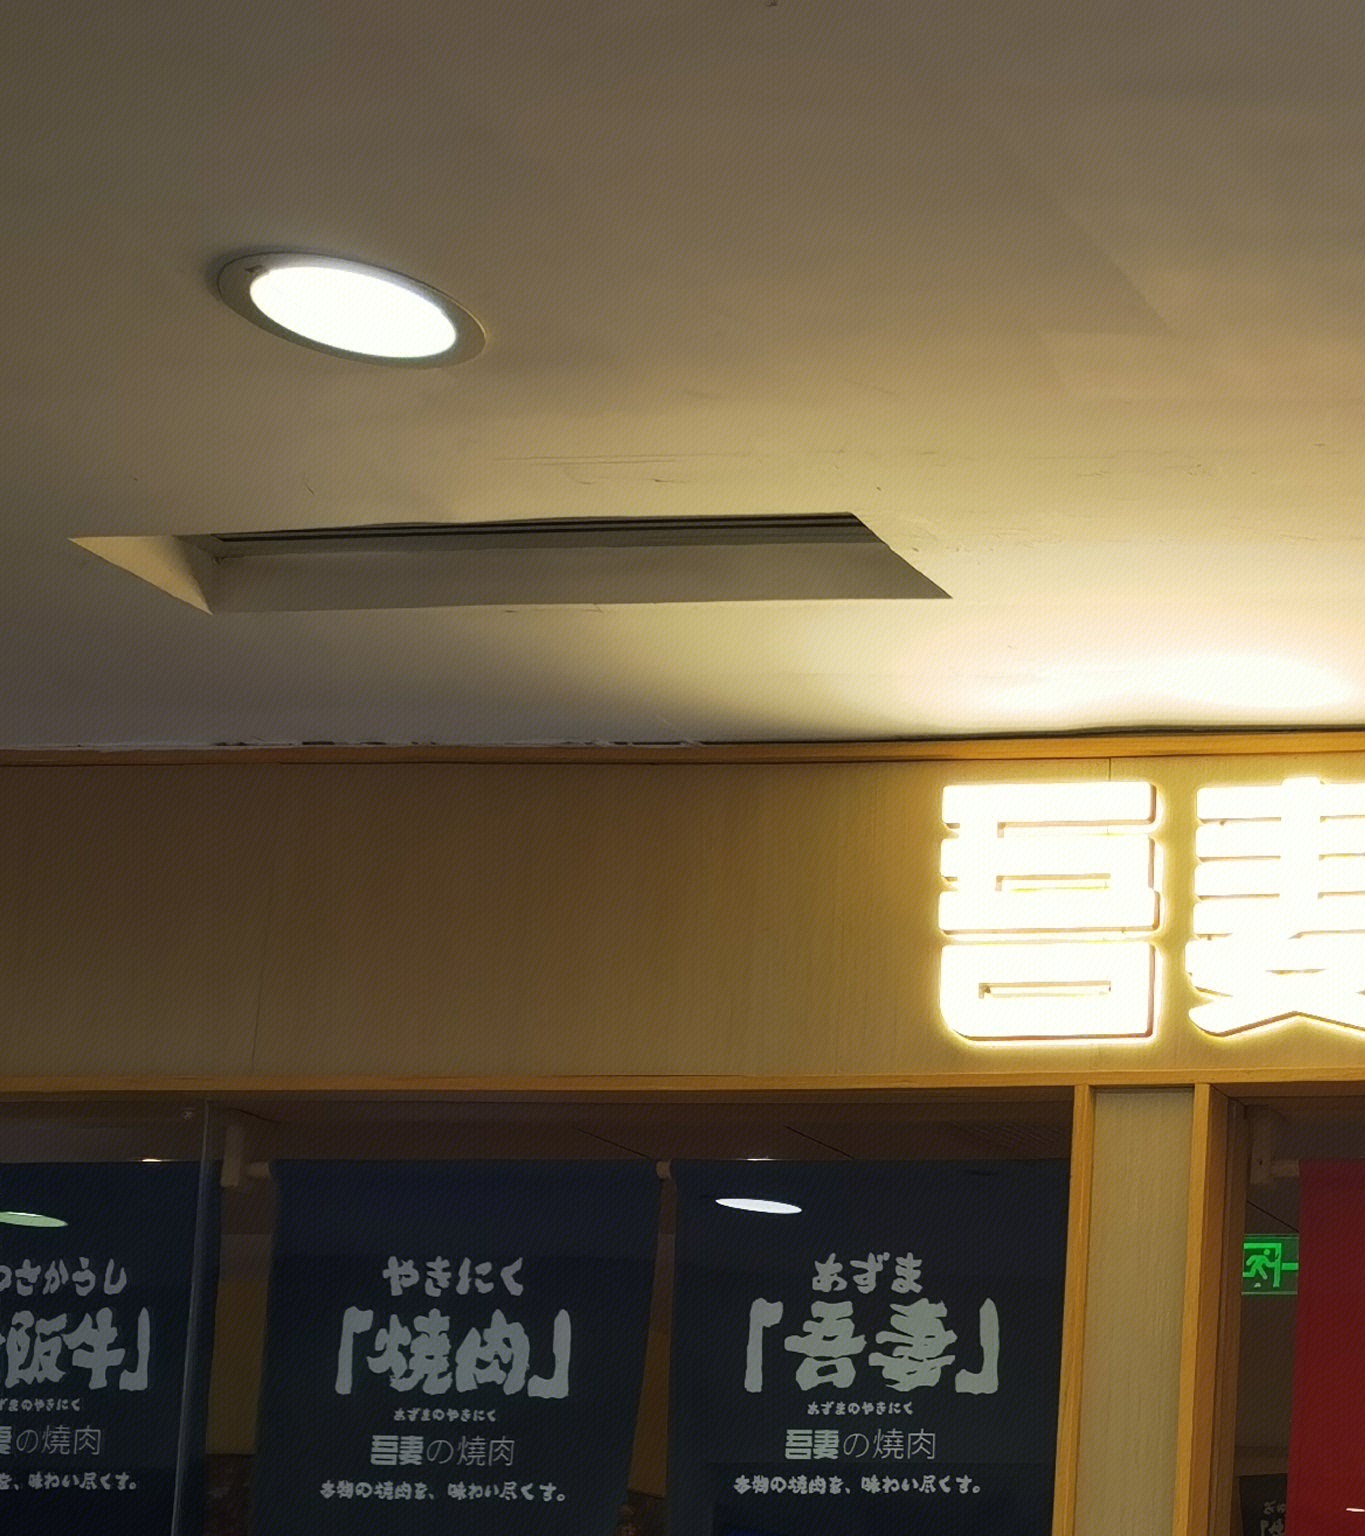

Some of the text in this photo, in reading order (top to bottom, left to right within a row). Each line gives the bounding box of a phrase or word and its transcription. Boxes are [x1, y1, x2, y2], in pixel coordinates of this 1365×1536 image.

[382, 1256, 524, 1297] やきにく
[810, 1252, 924, 1295] あずま
[0, 1306, 150, 1392] 阪牛」
[743, 1297, 1000, 1395] 「吾妻」
[370, 1434, 516, 1467] 吾妻の燒肉
[784, 1427, 937, 1460] 吾妻の燒肉
